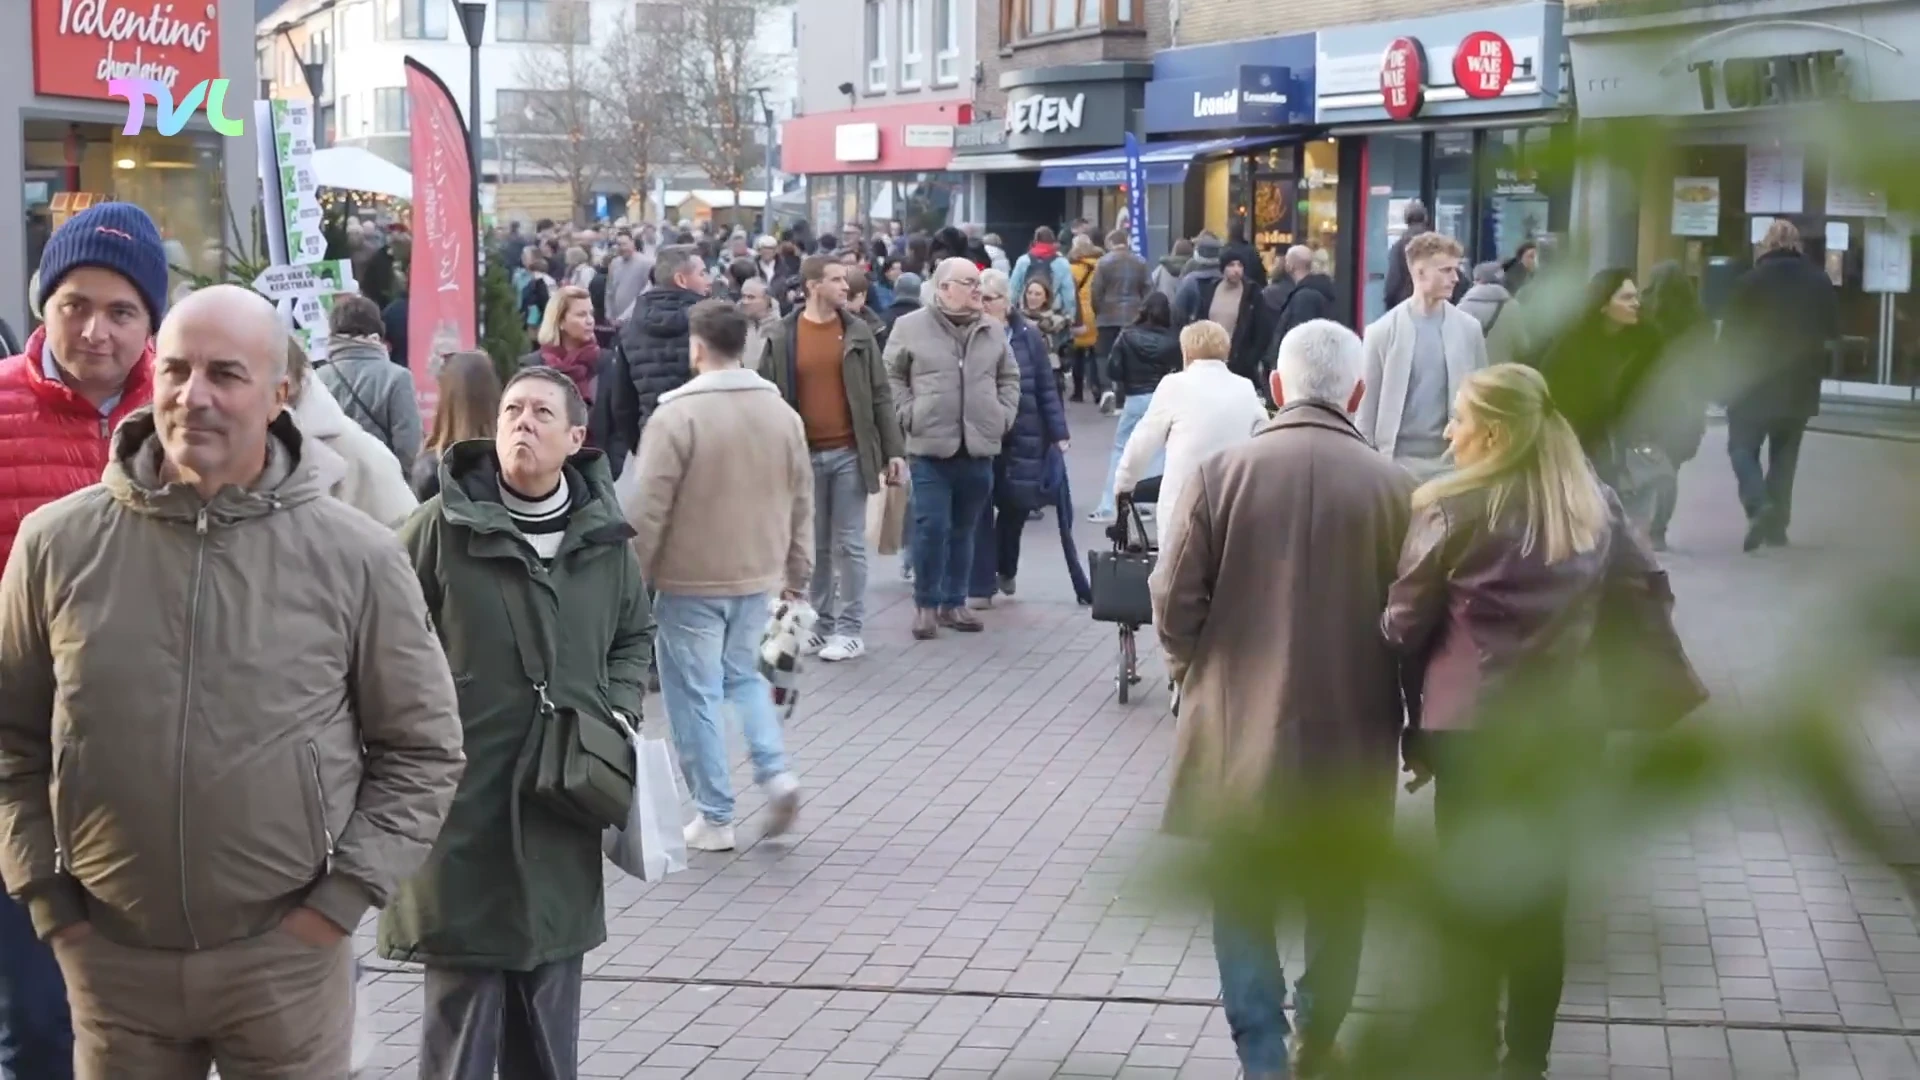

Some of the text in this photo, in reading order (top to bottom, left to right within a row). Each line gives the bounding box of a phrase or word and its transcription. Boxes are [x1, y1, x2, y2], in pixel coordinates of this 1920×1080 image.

[1479, 40, 1502, 57] DE
[1389, 49, 1406, 69] DE
[1466, 56, 1502, 73] WAE
[1383, 69, 1406, 87] WAE
[1479, 73, 1500, 90] LE
[1391, 87, 1407, 106] LE
[265, 273, 285, 283] HUIS
[287, 271, 304, 281] VAN
[270, 280, 315, 291] KERSTMAN
